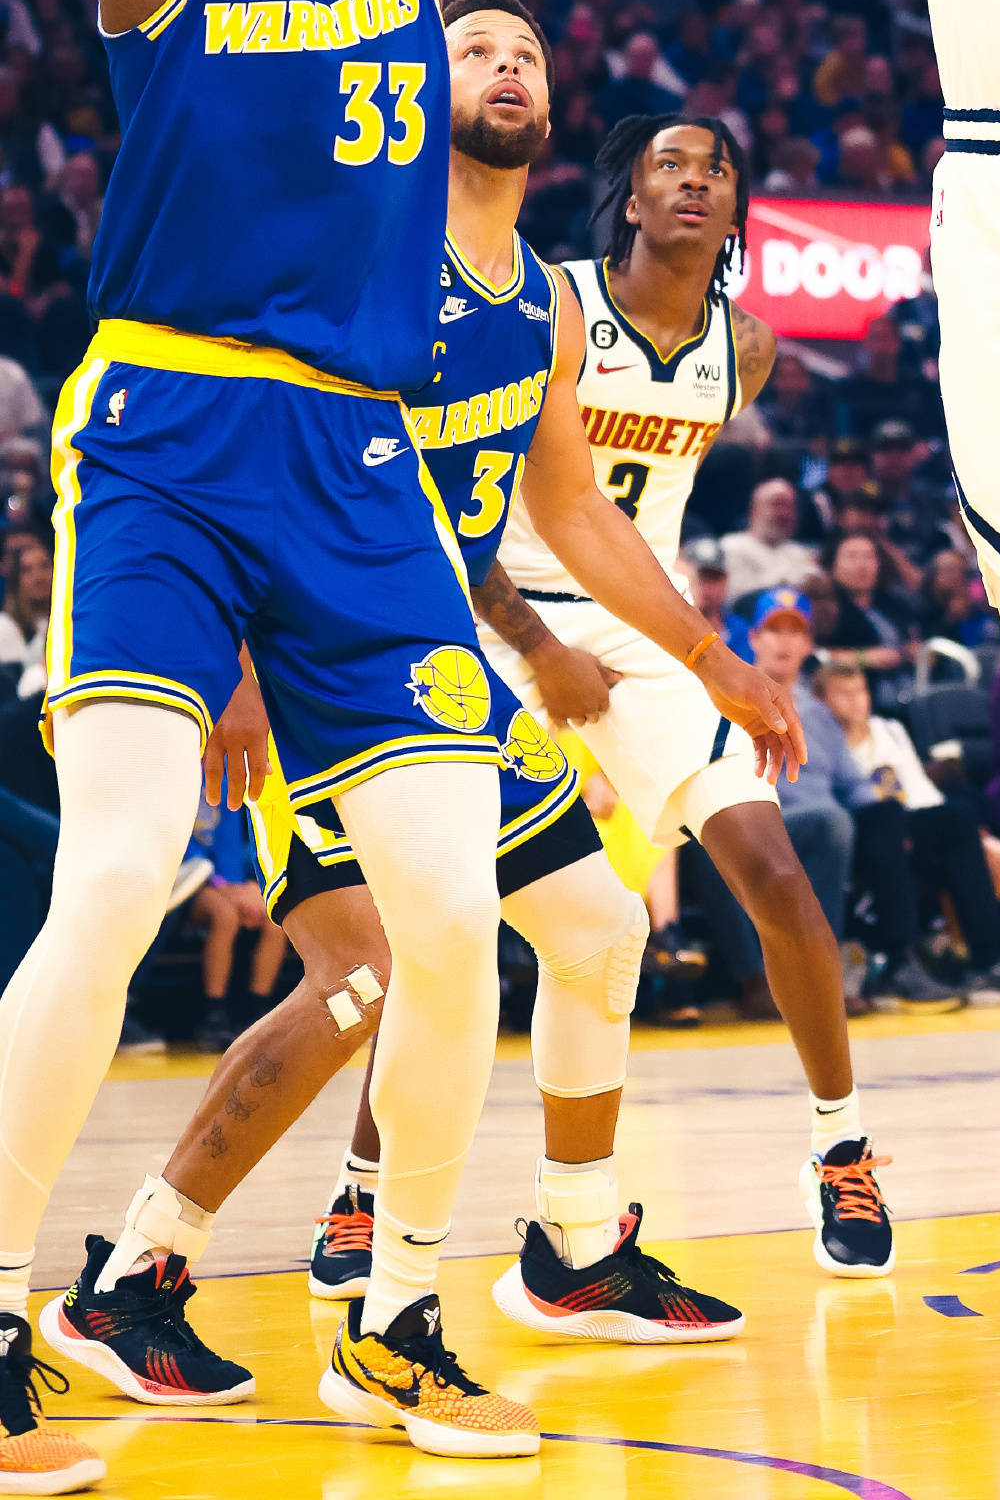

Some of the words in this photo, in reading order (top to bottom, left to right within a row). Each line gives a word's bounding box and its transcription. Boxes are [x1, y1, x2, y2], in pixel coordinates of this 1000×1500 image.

[333, 61, 426, 166] 33
[444, 296, 468, 314] NIKE
[518, 298, 550, 323] Rakuten
[595, 325, 612, 347] 6
[695, 363, 720, 381] WU
[409, 369, 548, 450] ARRIORS
[368, 437, 400, 455] NIKE
